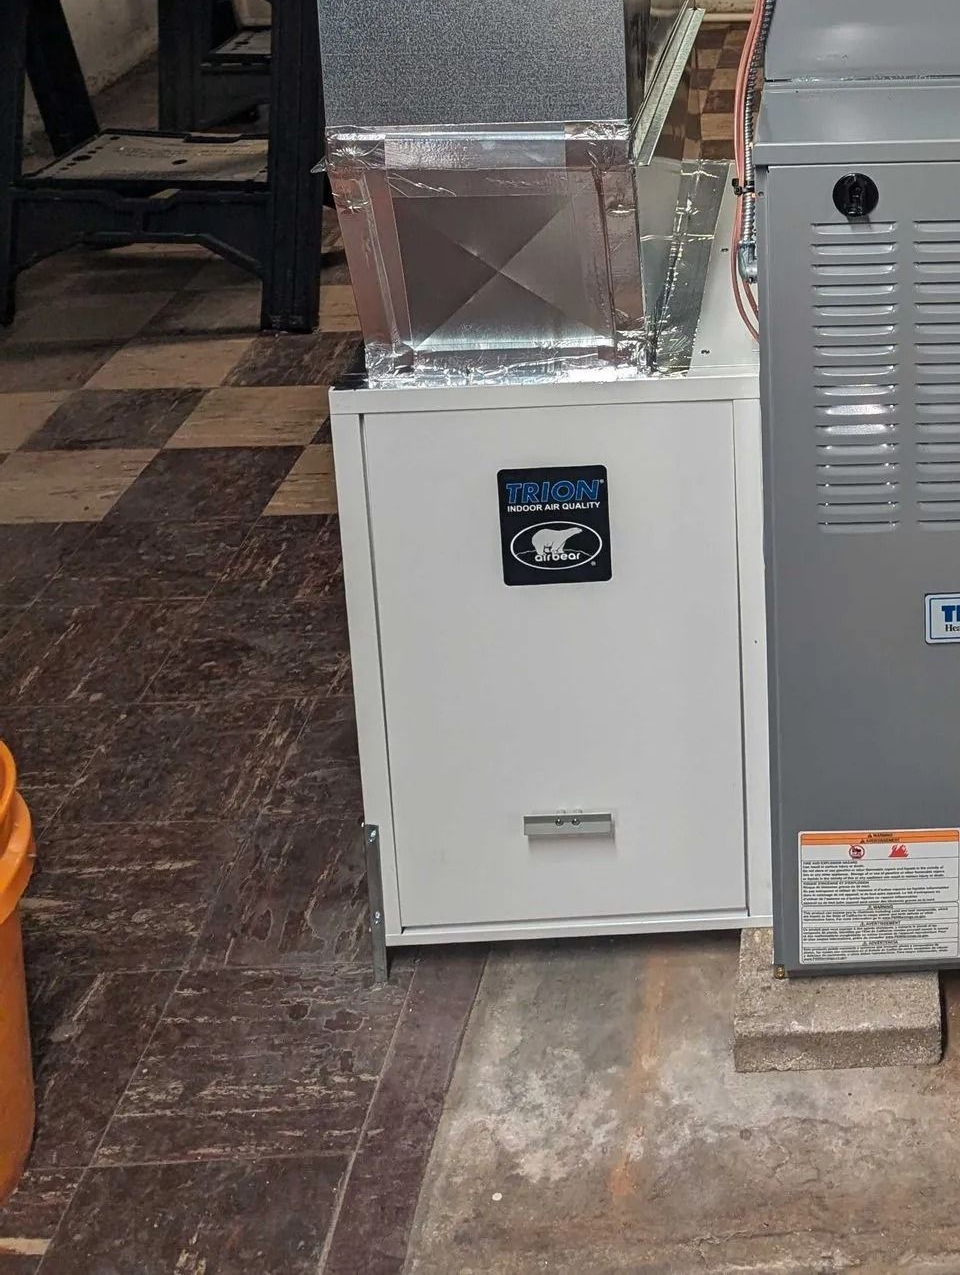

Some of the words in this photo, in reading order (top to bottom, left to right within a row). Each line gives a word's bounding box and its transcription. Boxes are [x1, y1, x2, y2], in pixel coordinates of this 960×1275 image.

[506, 480, 600, 503] TRION
[507, 503, 543, 513] INDOOR
[544, 503, 560, 511] AIR
[562, 501, 601, 510] QUALITY
[534, 553, 581, 562] airbear
